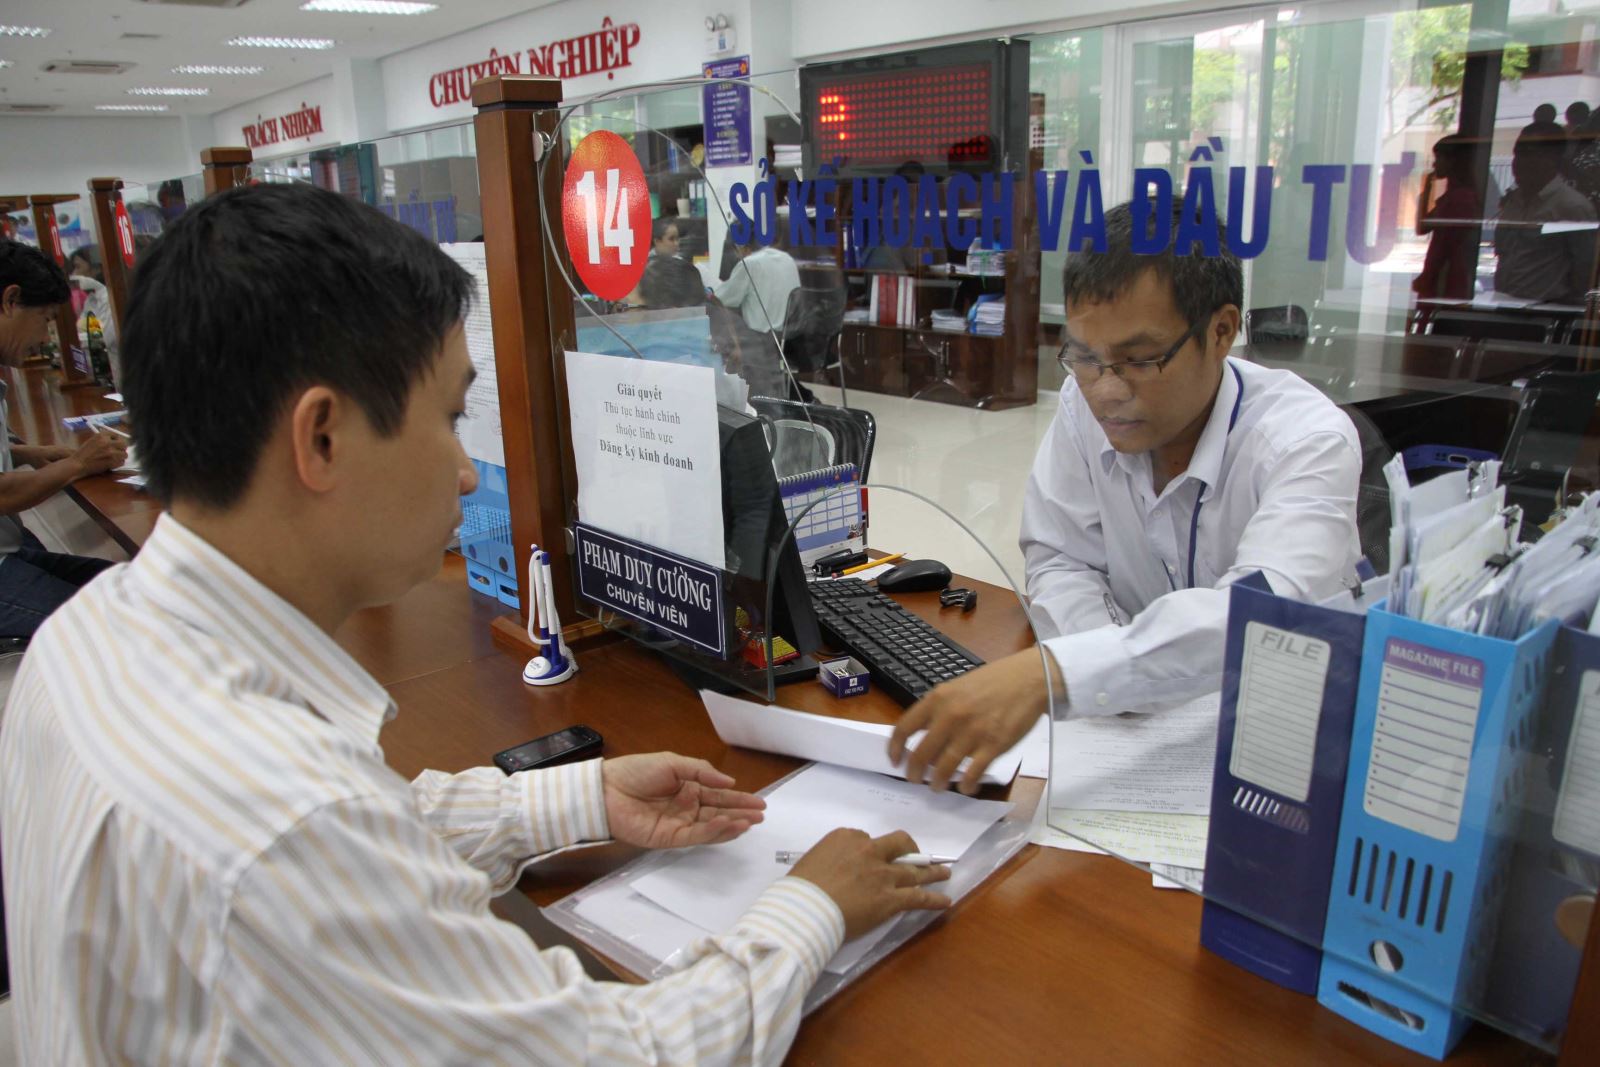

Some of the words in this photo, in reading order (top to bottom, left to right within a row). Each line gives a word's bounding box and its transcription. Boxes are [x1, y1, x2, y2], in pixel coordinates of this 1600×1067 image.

[527, 16, 640, 80] NGHIỆP
[242, 113, 279, 148] TRÁCH
[280, 101, 323, 142] NHIỆM
[576, 168, 634, 265] 14
[729, 157, 777, 247] SỞ
[788, 155, 841, 247] KẾ
[852, 171, 1015, 264] HOẠCH
[1033, 150, 1108, 253] VÀ
[1130, 136, 1273, 259] ĐẦU
[1302, 151, 1415, 265] TƯ
[118, 215, 133, 255] 16
[617, 382, 636, 397] Giải
[638, 384, 662, 402] quyết
[599, 439, 622, 457] Đăng
[639, 446, 660, 463] kinh
[663, 452, 693, 471] doanh
[583, 540, 622, 578] PHẠM
[624, 554, 653, 589] DUY
[657, 566, 712, 612] CƯỜNG
[606, 583, 655, 615] CHUYÊN
[658, 603, 688, 628] VIÊN
[1260, 629, 1322, 661] FILE
[1389, 644, 1450, 672] MAGAZINE
[1452, 661, 1480, 679] FILE
